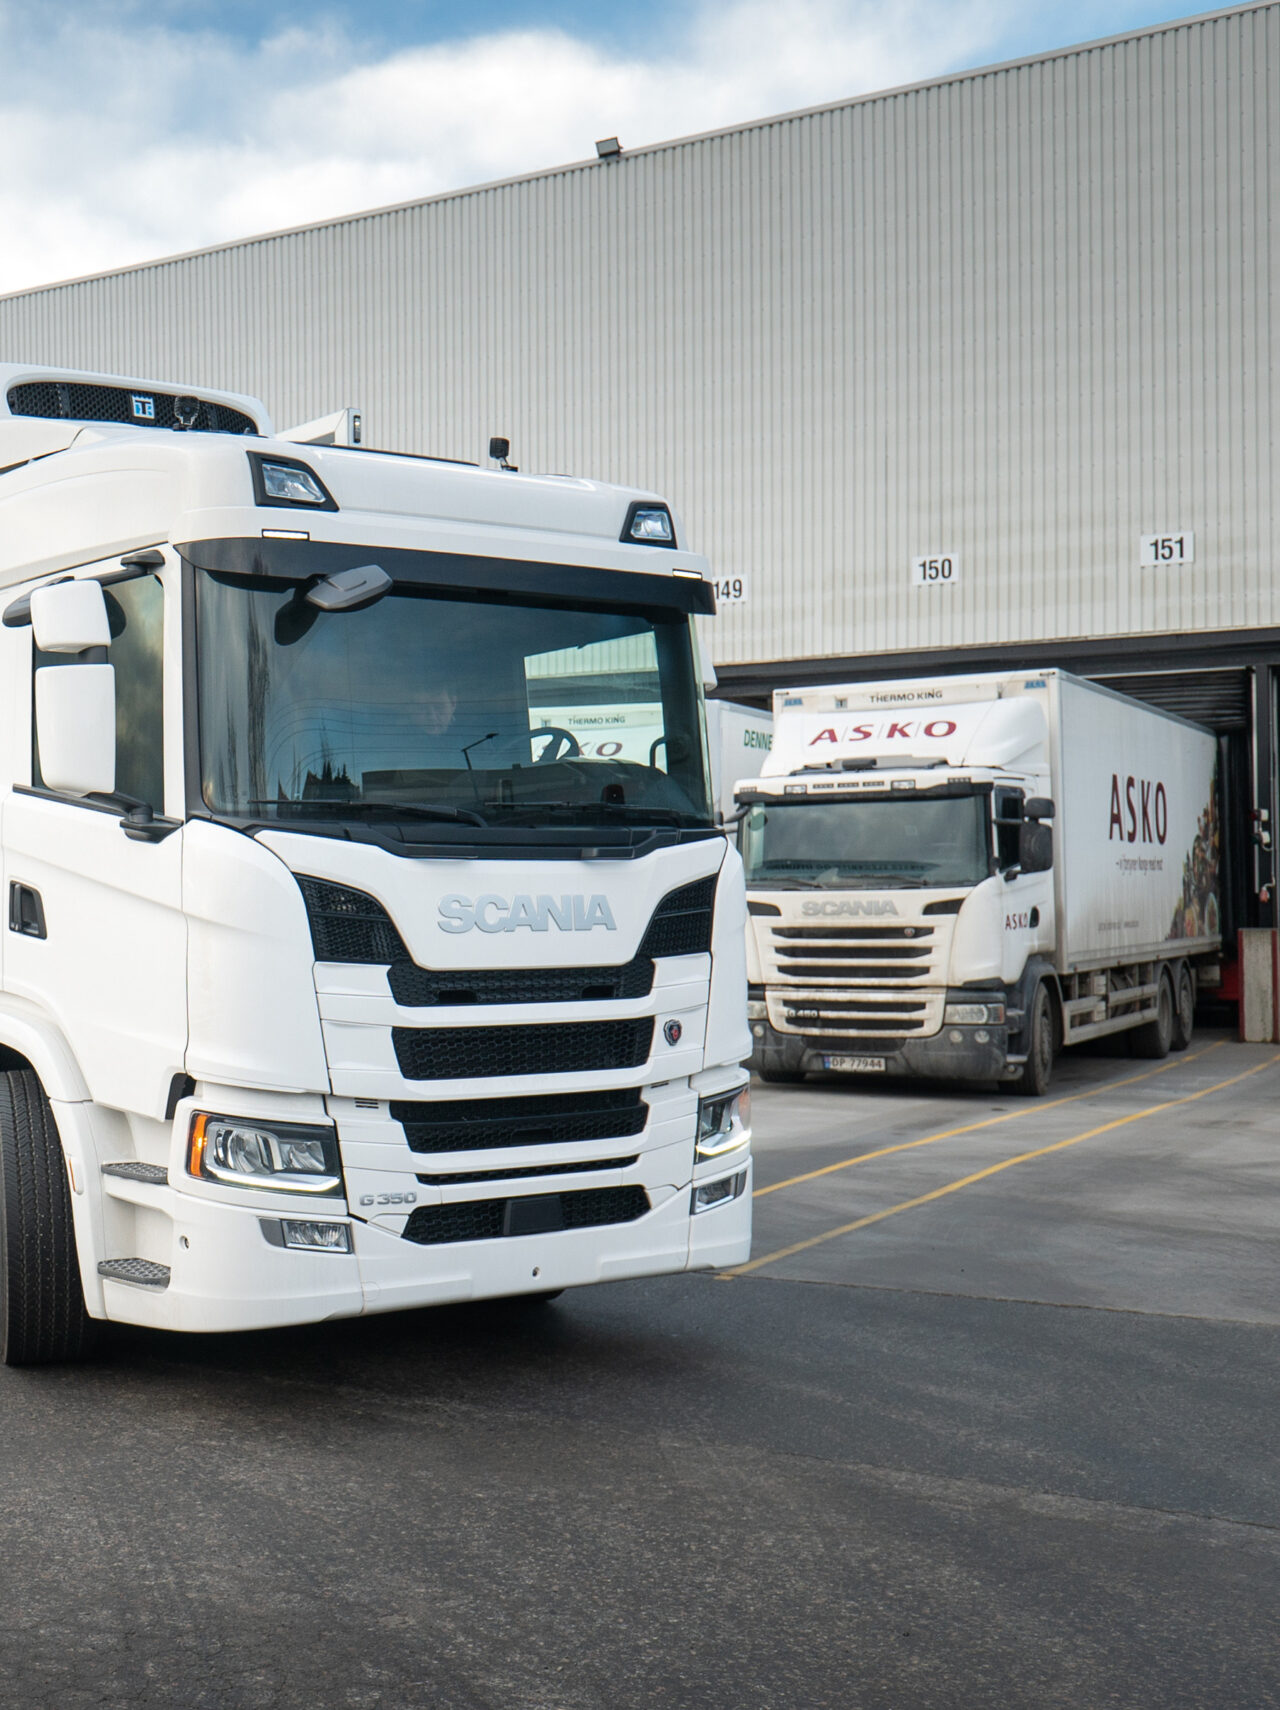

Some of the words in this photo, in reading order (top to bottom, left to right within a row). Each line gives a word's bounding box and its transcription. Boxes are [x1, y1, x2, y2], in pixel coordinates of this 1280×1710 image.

[1149, 537, 1186, 561] 151
[918, 558, 953, 581] 150
[714, 579, 743, 600] 149
[869, 692, 915, 703] THERMO
[917, 689, 943, 700] KING
[744, 729, 773, 751] DENNE
[808, 721, 957, 746] ASKO
[1109, 774, 1167, 845] ASKO
[437, 894, 617, 934] SCANIA
[801, 900, 898, 917] SCANIA
[360, 1194, 375, 1206] G
[377, 1192, 417, 1205] 350
